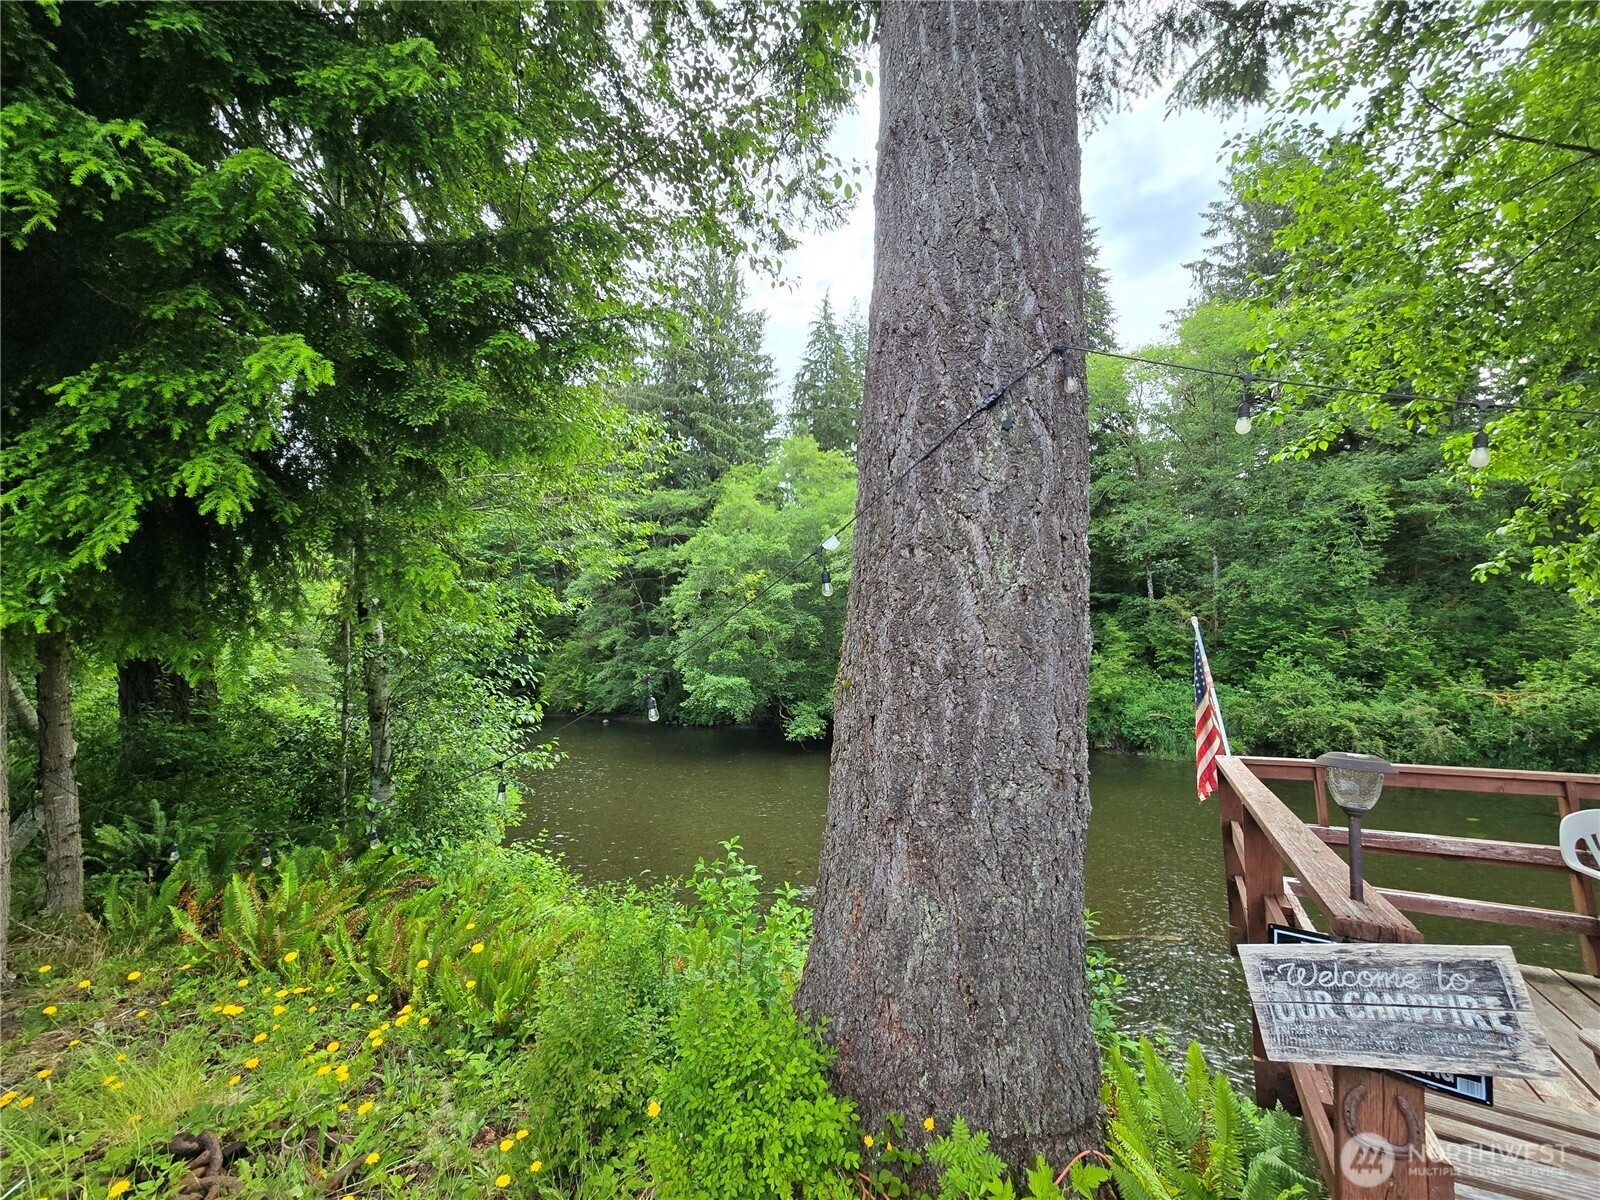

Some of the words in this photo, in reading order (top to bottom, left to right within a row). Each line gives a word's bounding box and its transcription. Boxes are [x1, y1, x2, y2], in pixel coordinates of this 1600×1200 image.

[1277, 961, 1421, 990] Welcome
[1431, 963, 1476, 991] to
[1274, 988, 1341, 1022] OUR
[1342, 990, 1514, 1035] CAMPFIRE
